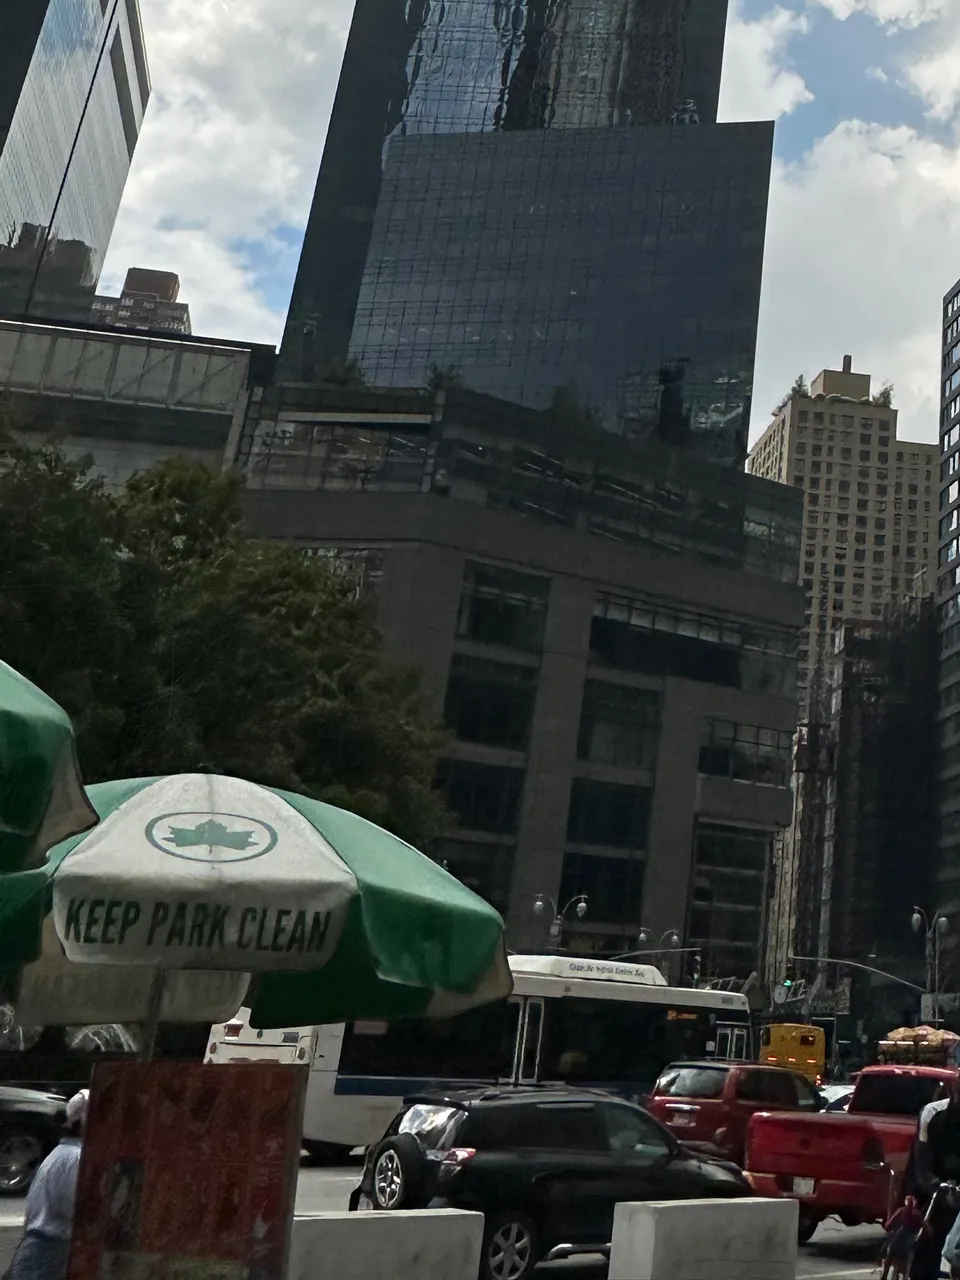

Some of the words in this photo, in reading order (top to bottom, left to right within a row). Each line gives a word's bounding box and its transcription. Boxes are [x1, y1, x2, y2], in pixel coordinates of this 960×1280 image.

[64, 897, 141, 945] KEEP
[146, 900, 232, 949] PARK
[236, 906, 333, 953] CLEAN
